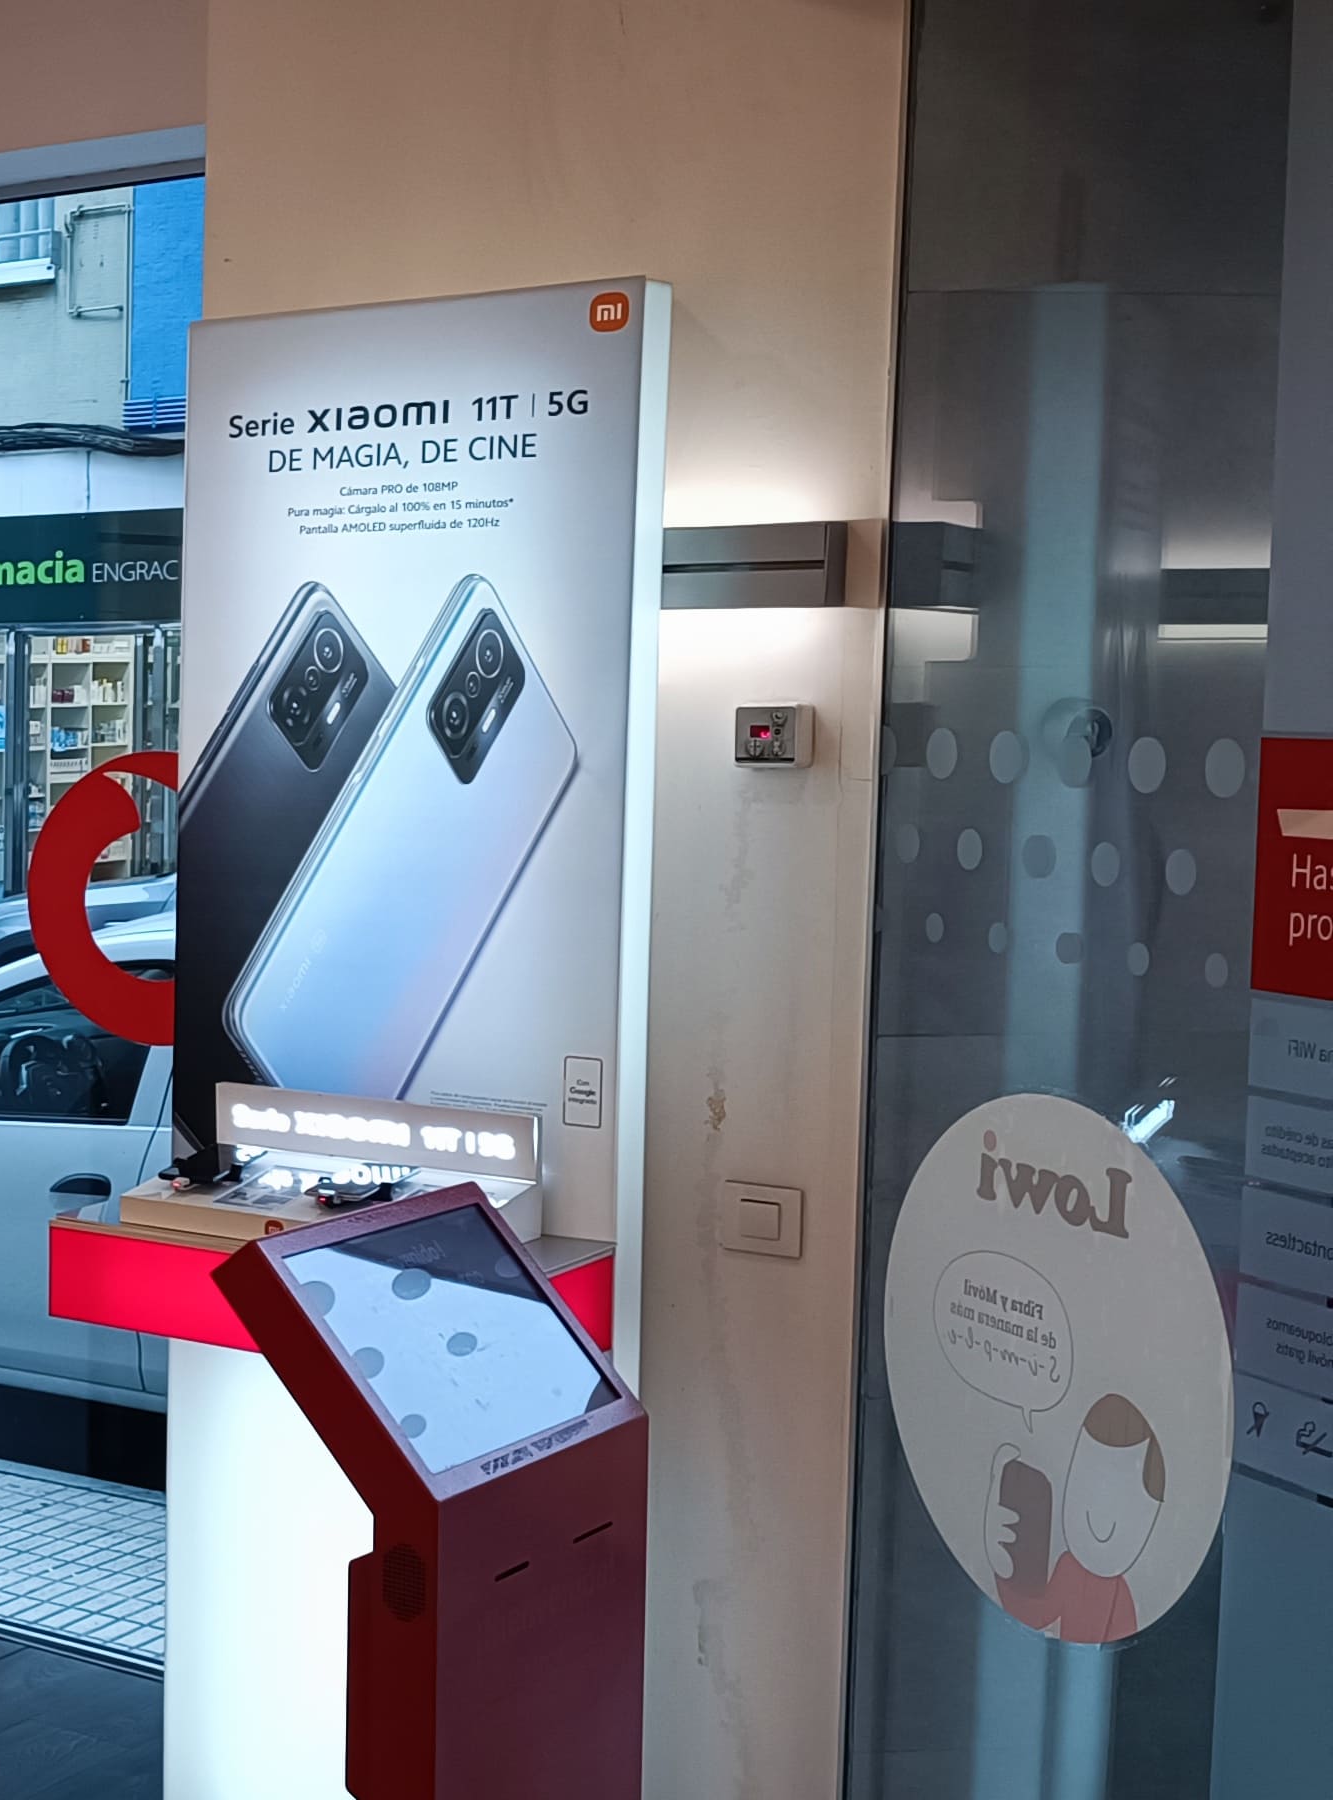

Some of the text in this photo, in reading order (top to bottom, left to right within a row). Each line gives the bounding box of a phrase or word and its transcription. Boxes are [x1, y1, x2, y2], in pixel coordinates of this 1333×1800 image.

[228, 411, 296, 439] Serie
[471, 394, 520, 423] 11T
[547, 389, 590, 417] 5G
[268, 433, 538, 473] DE MAGIA, DE CINE
[339, 480, 459, 497] Cámara PRO de 108MP
[287, 507, 309, 519] Pura
[312, 507, 345, 519] magia:
[347, 502, 387, 517] Cárgalo
[389, 502, 399, 514] al
[401, 500, 431, 513] 100%
[433, 501, 446, 512] en
[450, 499, 463, 511] 15
[299, 516, 501, 536] Pantalla AMOLED superfluida de 120Hz
[92, 559, 179, 583] ENGRAC
[1289, 911, 1333, 947] pro
